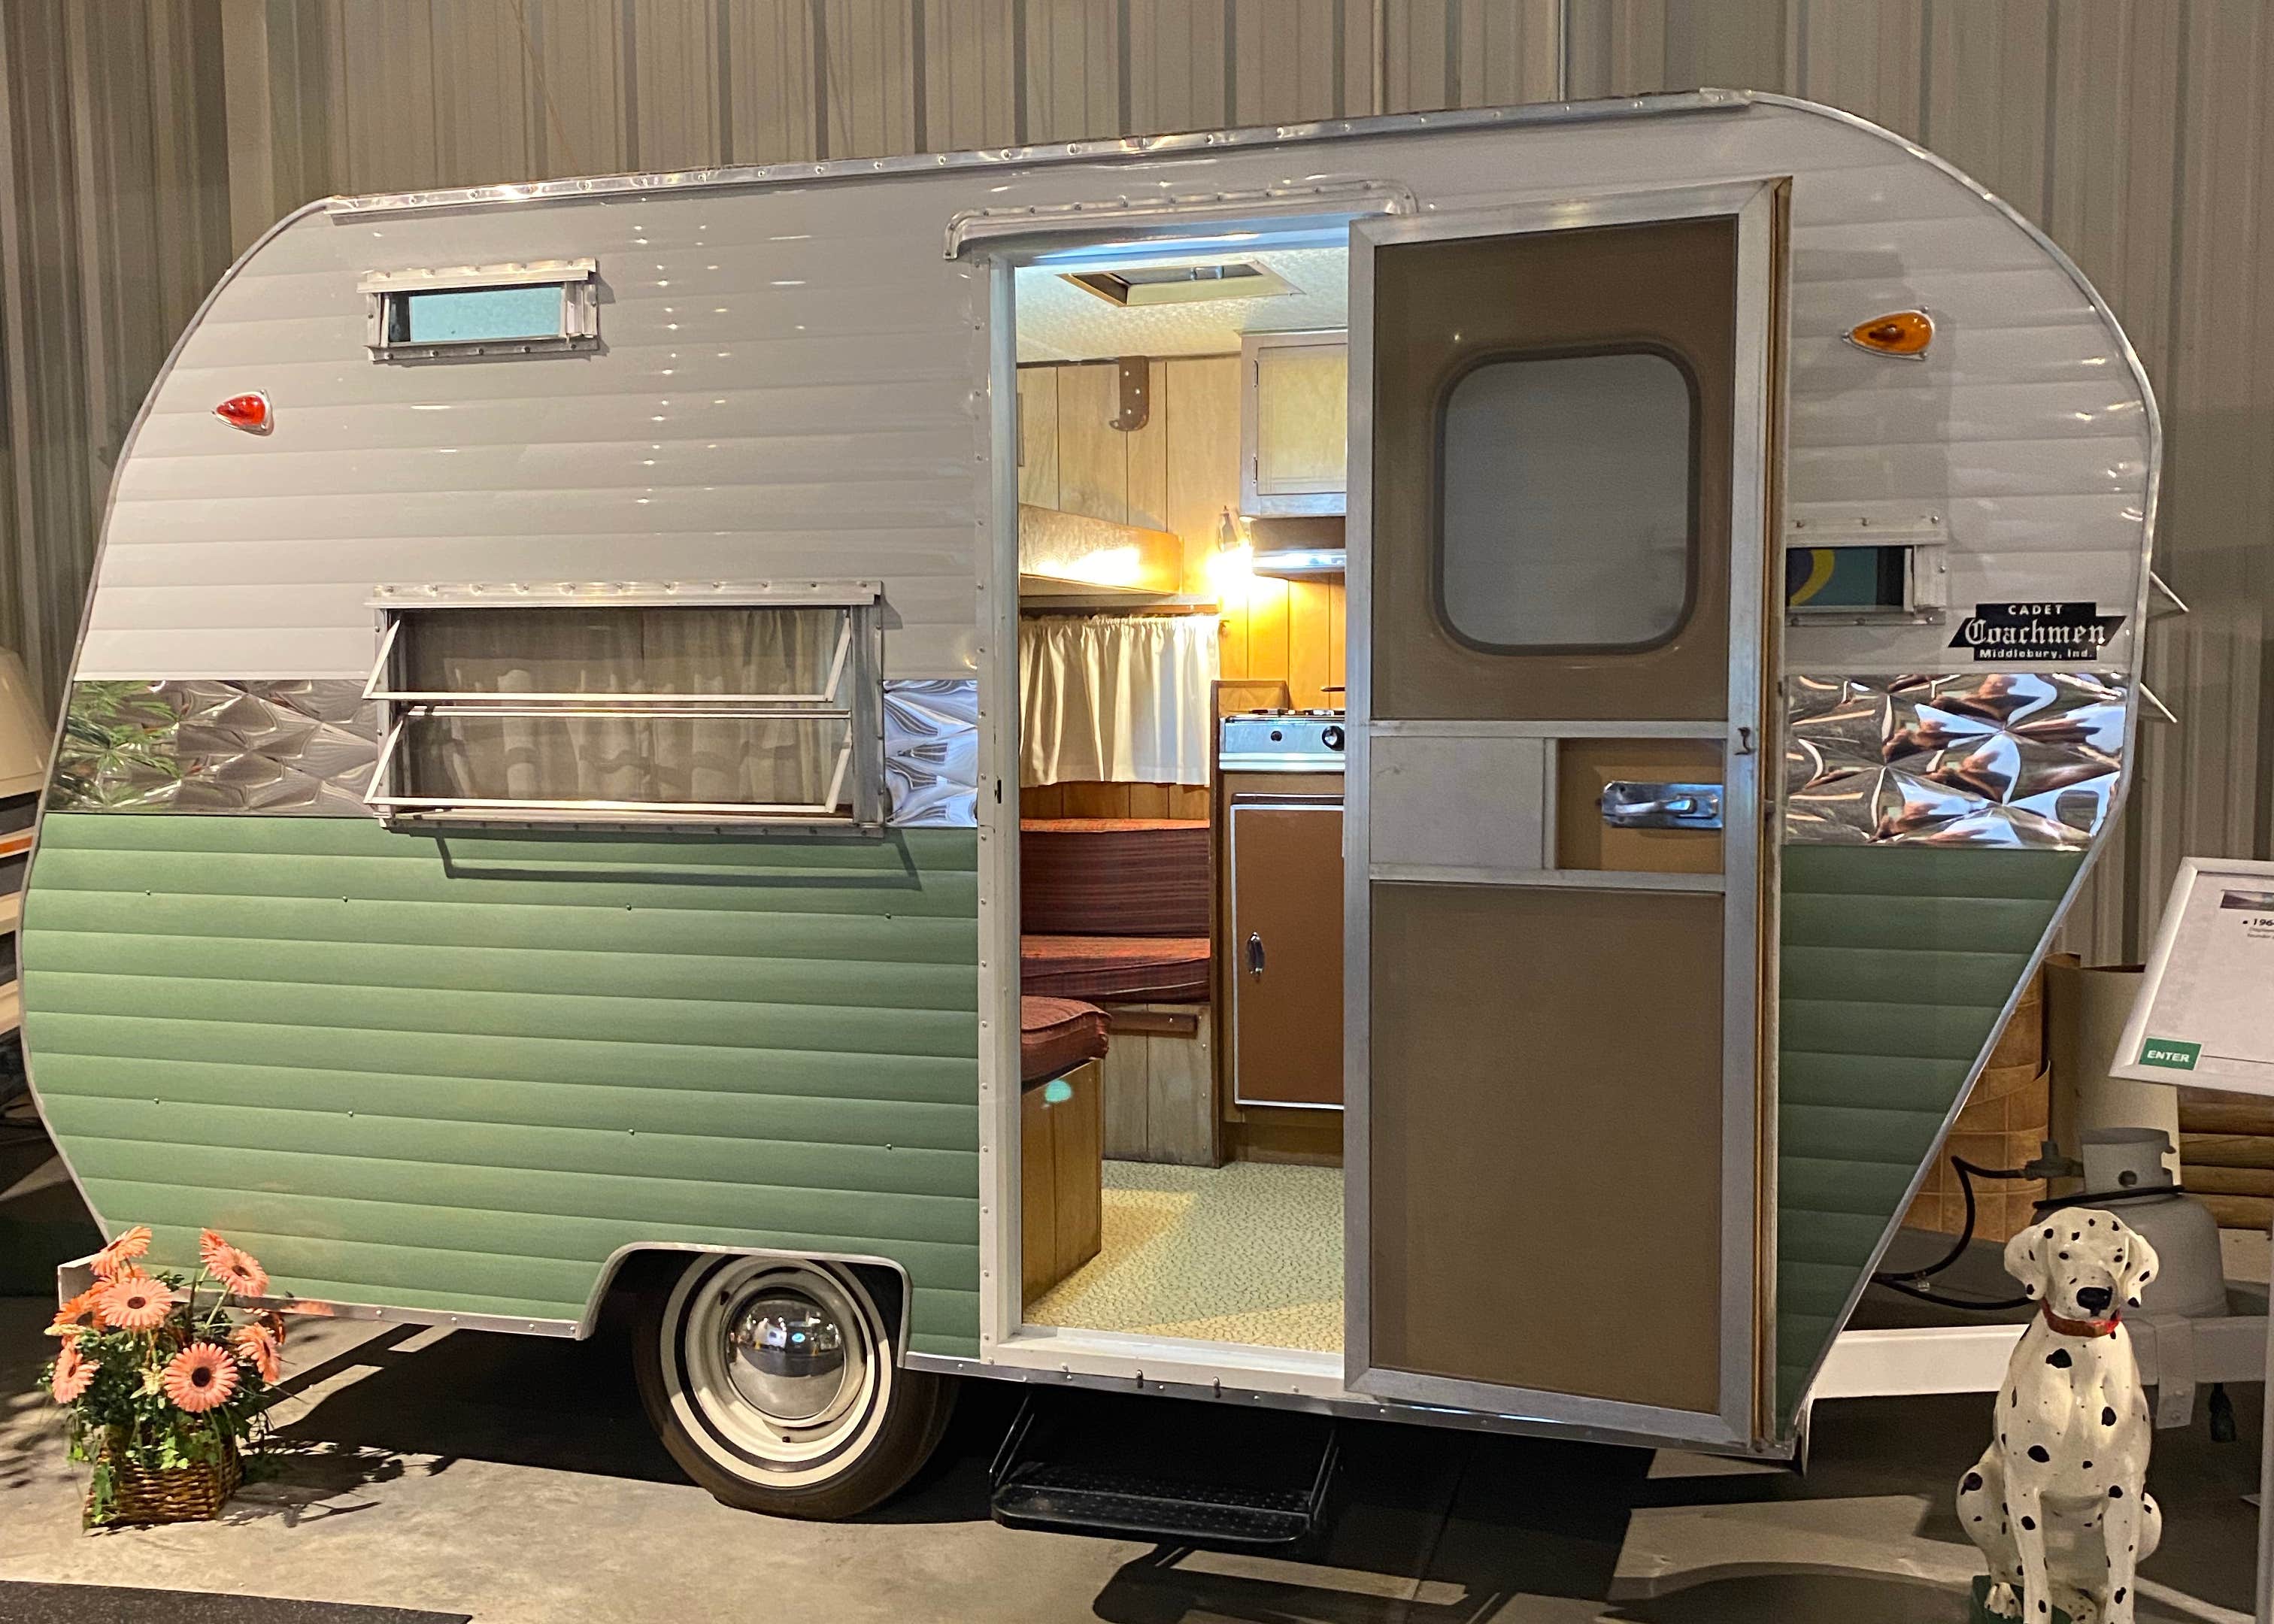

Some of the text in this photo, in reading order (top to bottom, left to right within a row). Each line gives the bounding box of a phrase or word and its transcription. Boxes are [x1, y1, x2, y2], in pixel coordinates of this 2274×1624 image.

[2008, 604, 2064, 615] CADET
[1964, 618, 2106, 645] Coachmen
[1979, 649, 2094, 659] Middlebury, Ind.
[2253, 918, 2274, 926] 196
[2147, 1050, 2190, 1062] ENTER
